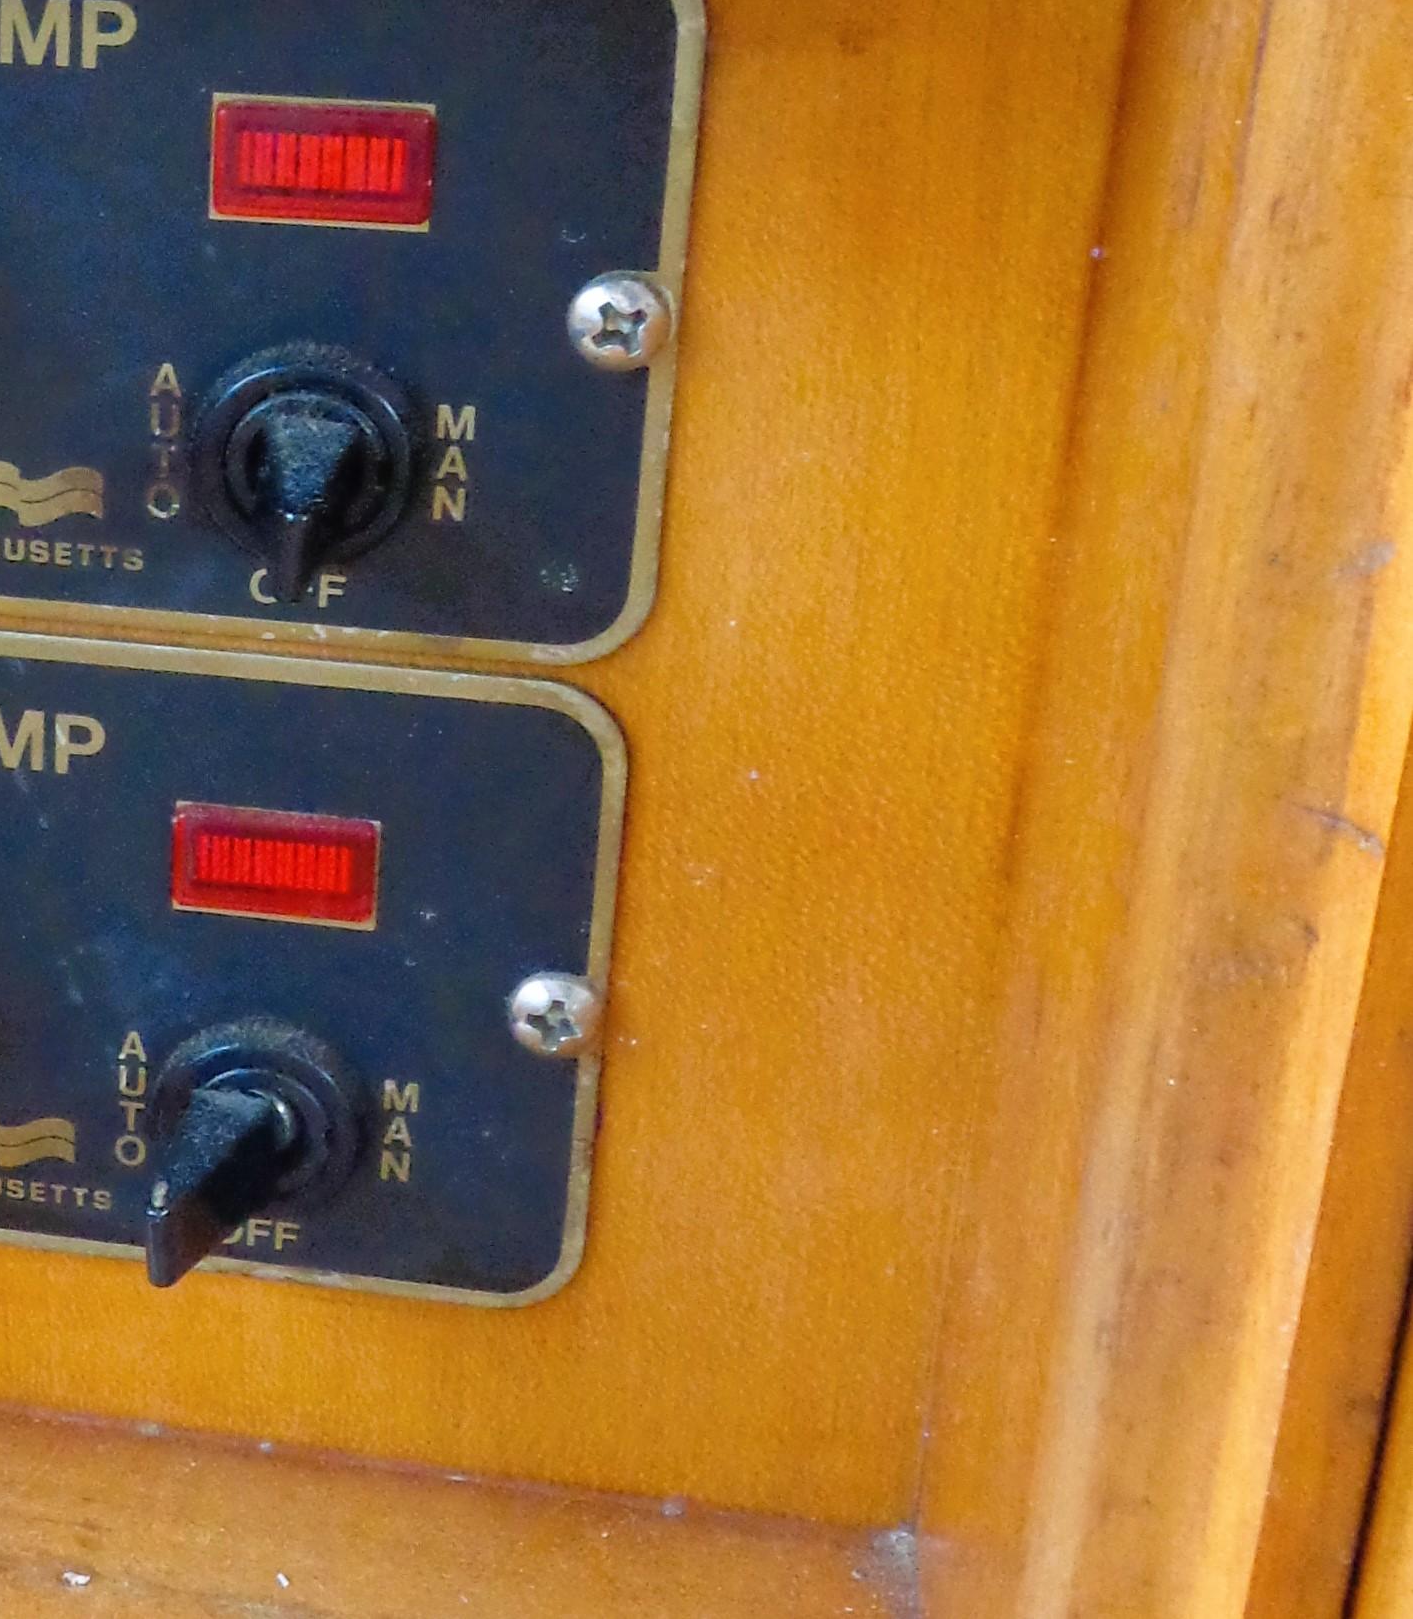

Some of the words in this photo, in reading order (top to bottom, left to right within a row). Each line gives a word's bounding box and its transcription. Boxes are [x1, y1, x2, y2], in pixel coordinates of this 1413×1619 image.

[147, 363, 183, 519] AUTO
[431, 404, 476, 522] MAN
[114, 1031, 148, 1167] AUTO
[380, 1079, 420, 1182] MAN
